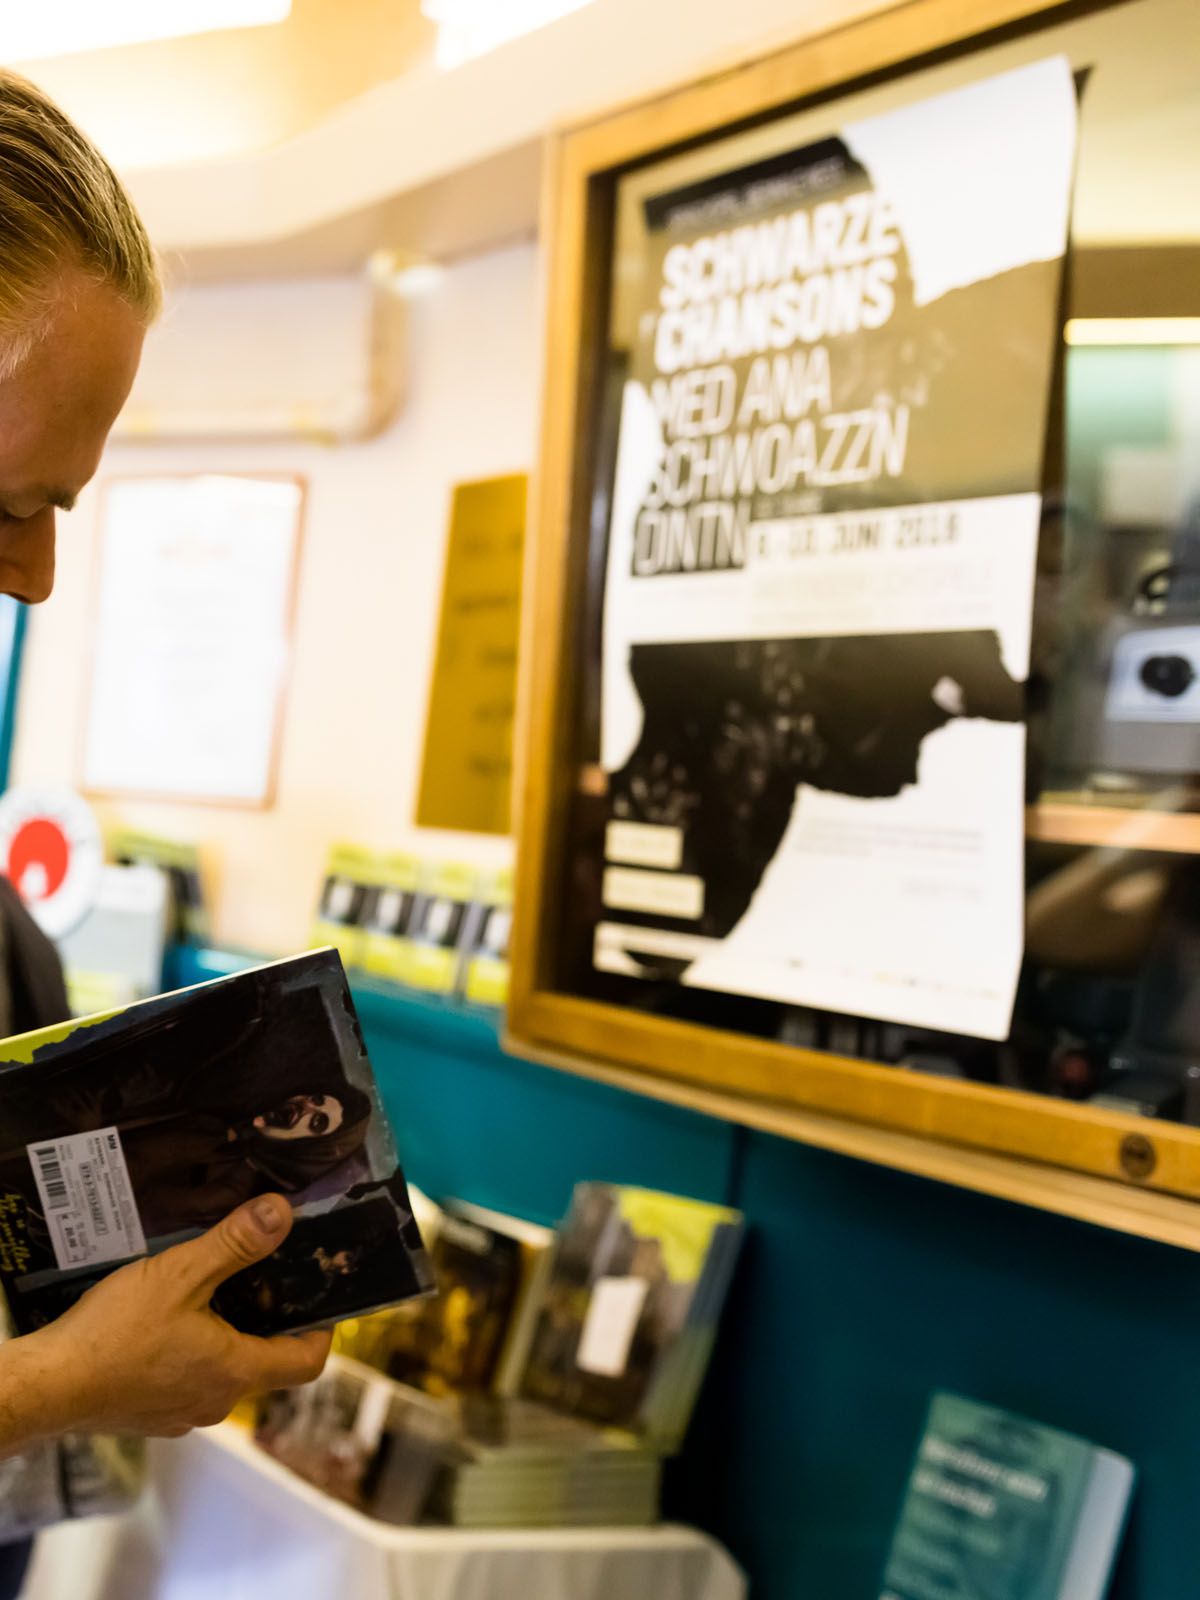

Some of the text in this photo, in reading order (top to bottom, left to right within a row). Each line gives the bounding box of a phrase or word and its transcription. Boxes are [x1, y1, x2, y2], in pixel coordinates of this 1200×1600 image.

[658, 192, 901, 309] SCHWARZE
[654, 255, 899, 374] CHANSONS
[737, 345, 832, 426] ANA
